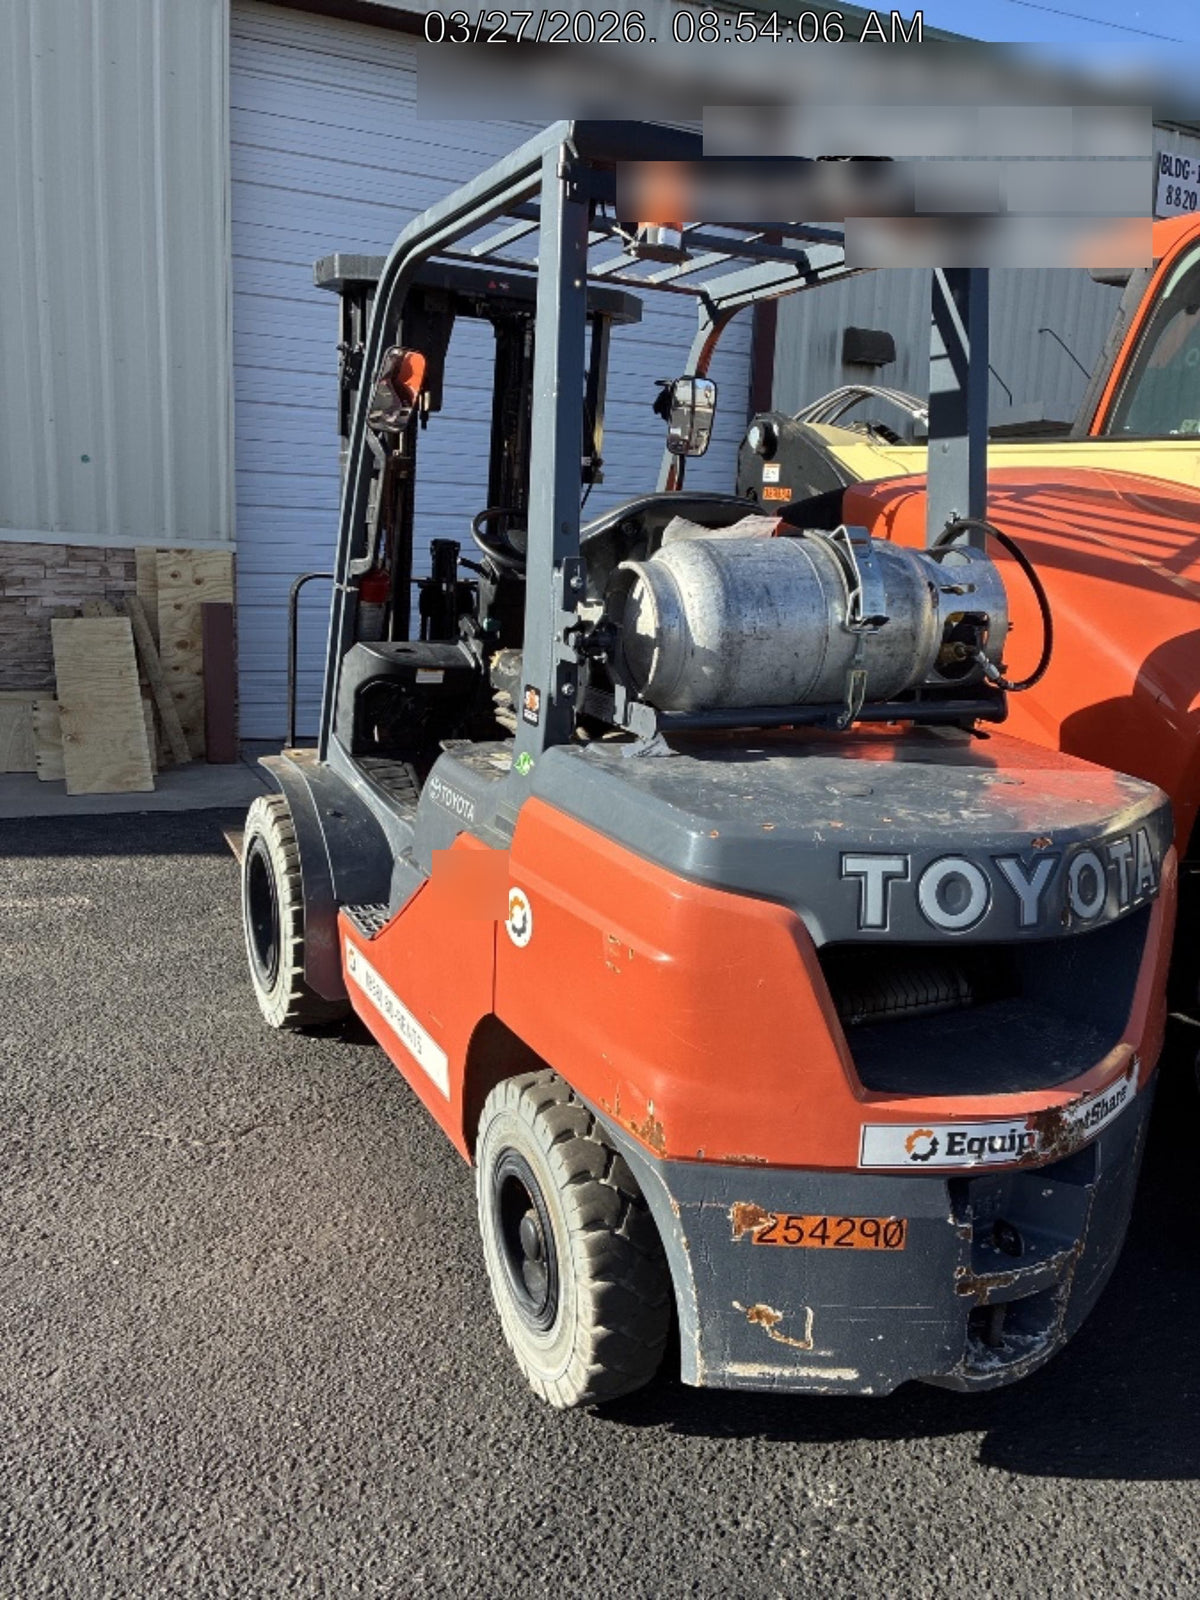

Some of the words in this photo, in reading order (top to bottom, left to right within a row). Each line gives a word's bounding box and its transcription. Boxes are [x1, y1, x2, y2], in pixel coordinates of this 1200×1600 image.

[1166, 184, 1197, 211] 8820
[442, 785, 474, 822] TOYOTA
[840, 826, 1158, 934] TOYOTA
[757, 1213, 905, 1249] 254290
